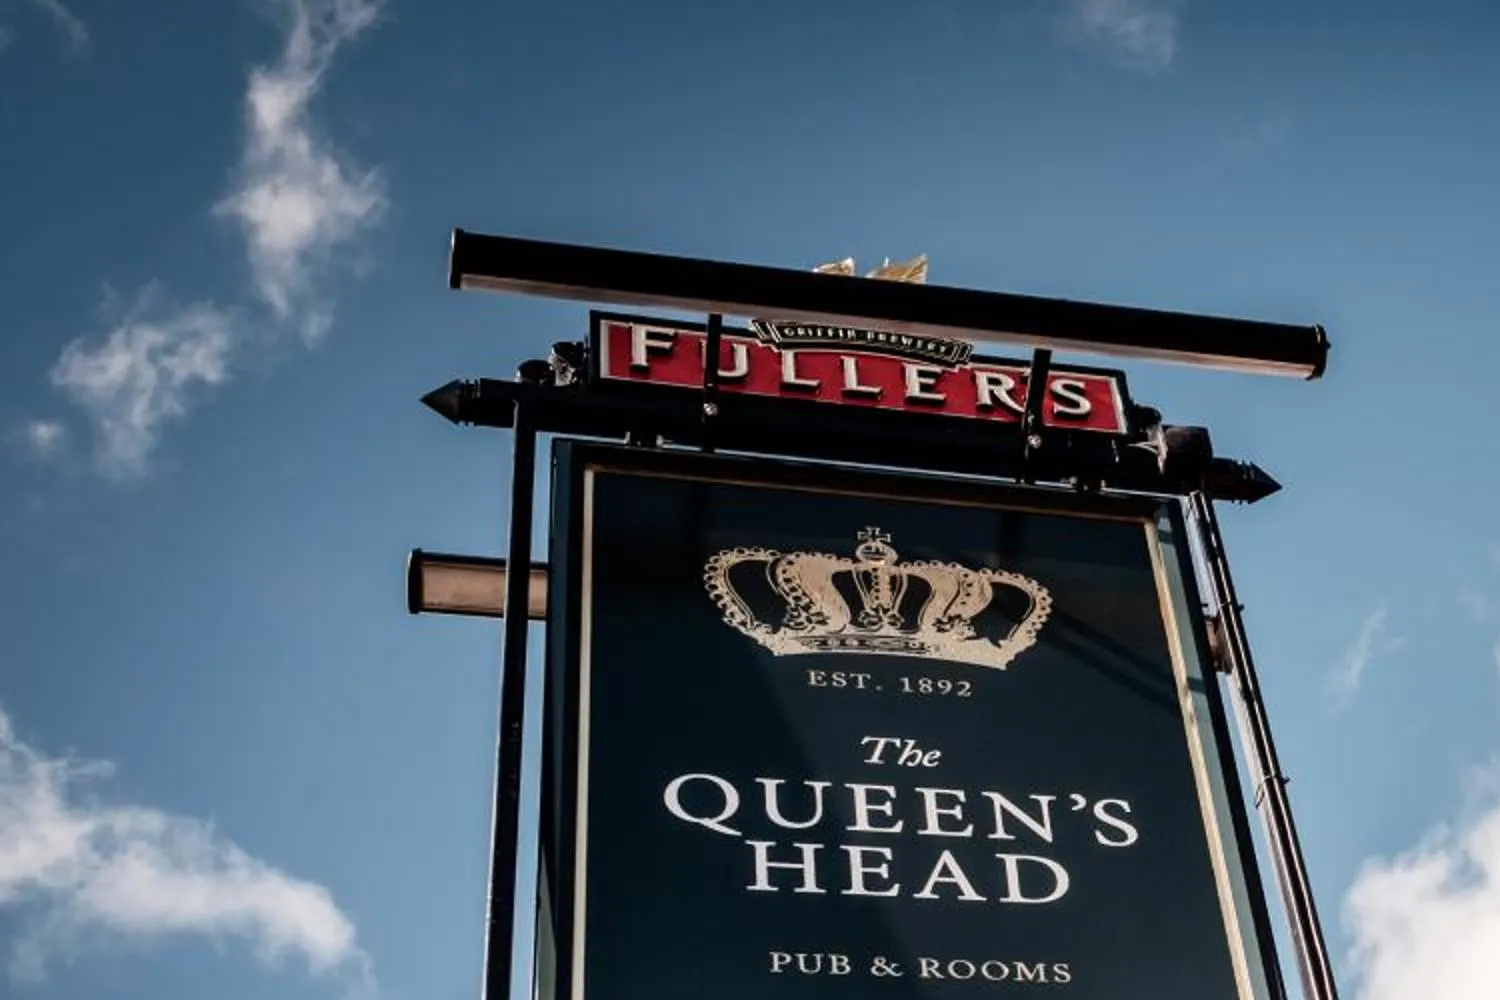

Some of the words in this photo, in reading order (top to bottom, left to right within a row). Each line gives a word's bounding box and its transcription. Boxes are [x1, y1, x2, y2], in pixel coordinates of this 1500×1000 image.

[783, 326, 857, 340] GRIFFIN
[630, 322, 1092, 415] FULLER'S
[806, 669, 884, 691] EST.
[899, 676, 973, 697] 1892
[860, 736, 942, 768] The
[663, 773, 1139, 847] QUEEN'S
[745, 840, 1070, 904] HEAD
[768, 951, 851, 975] PUB
[870, 956, 904, 977] &
[919, 957, 1072, 984] ROOMS
